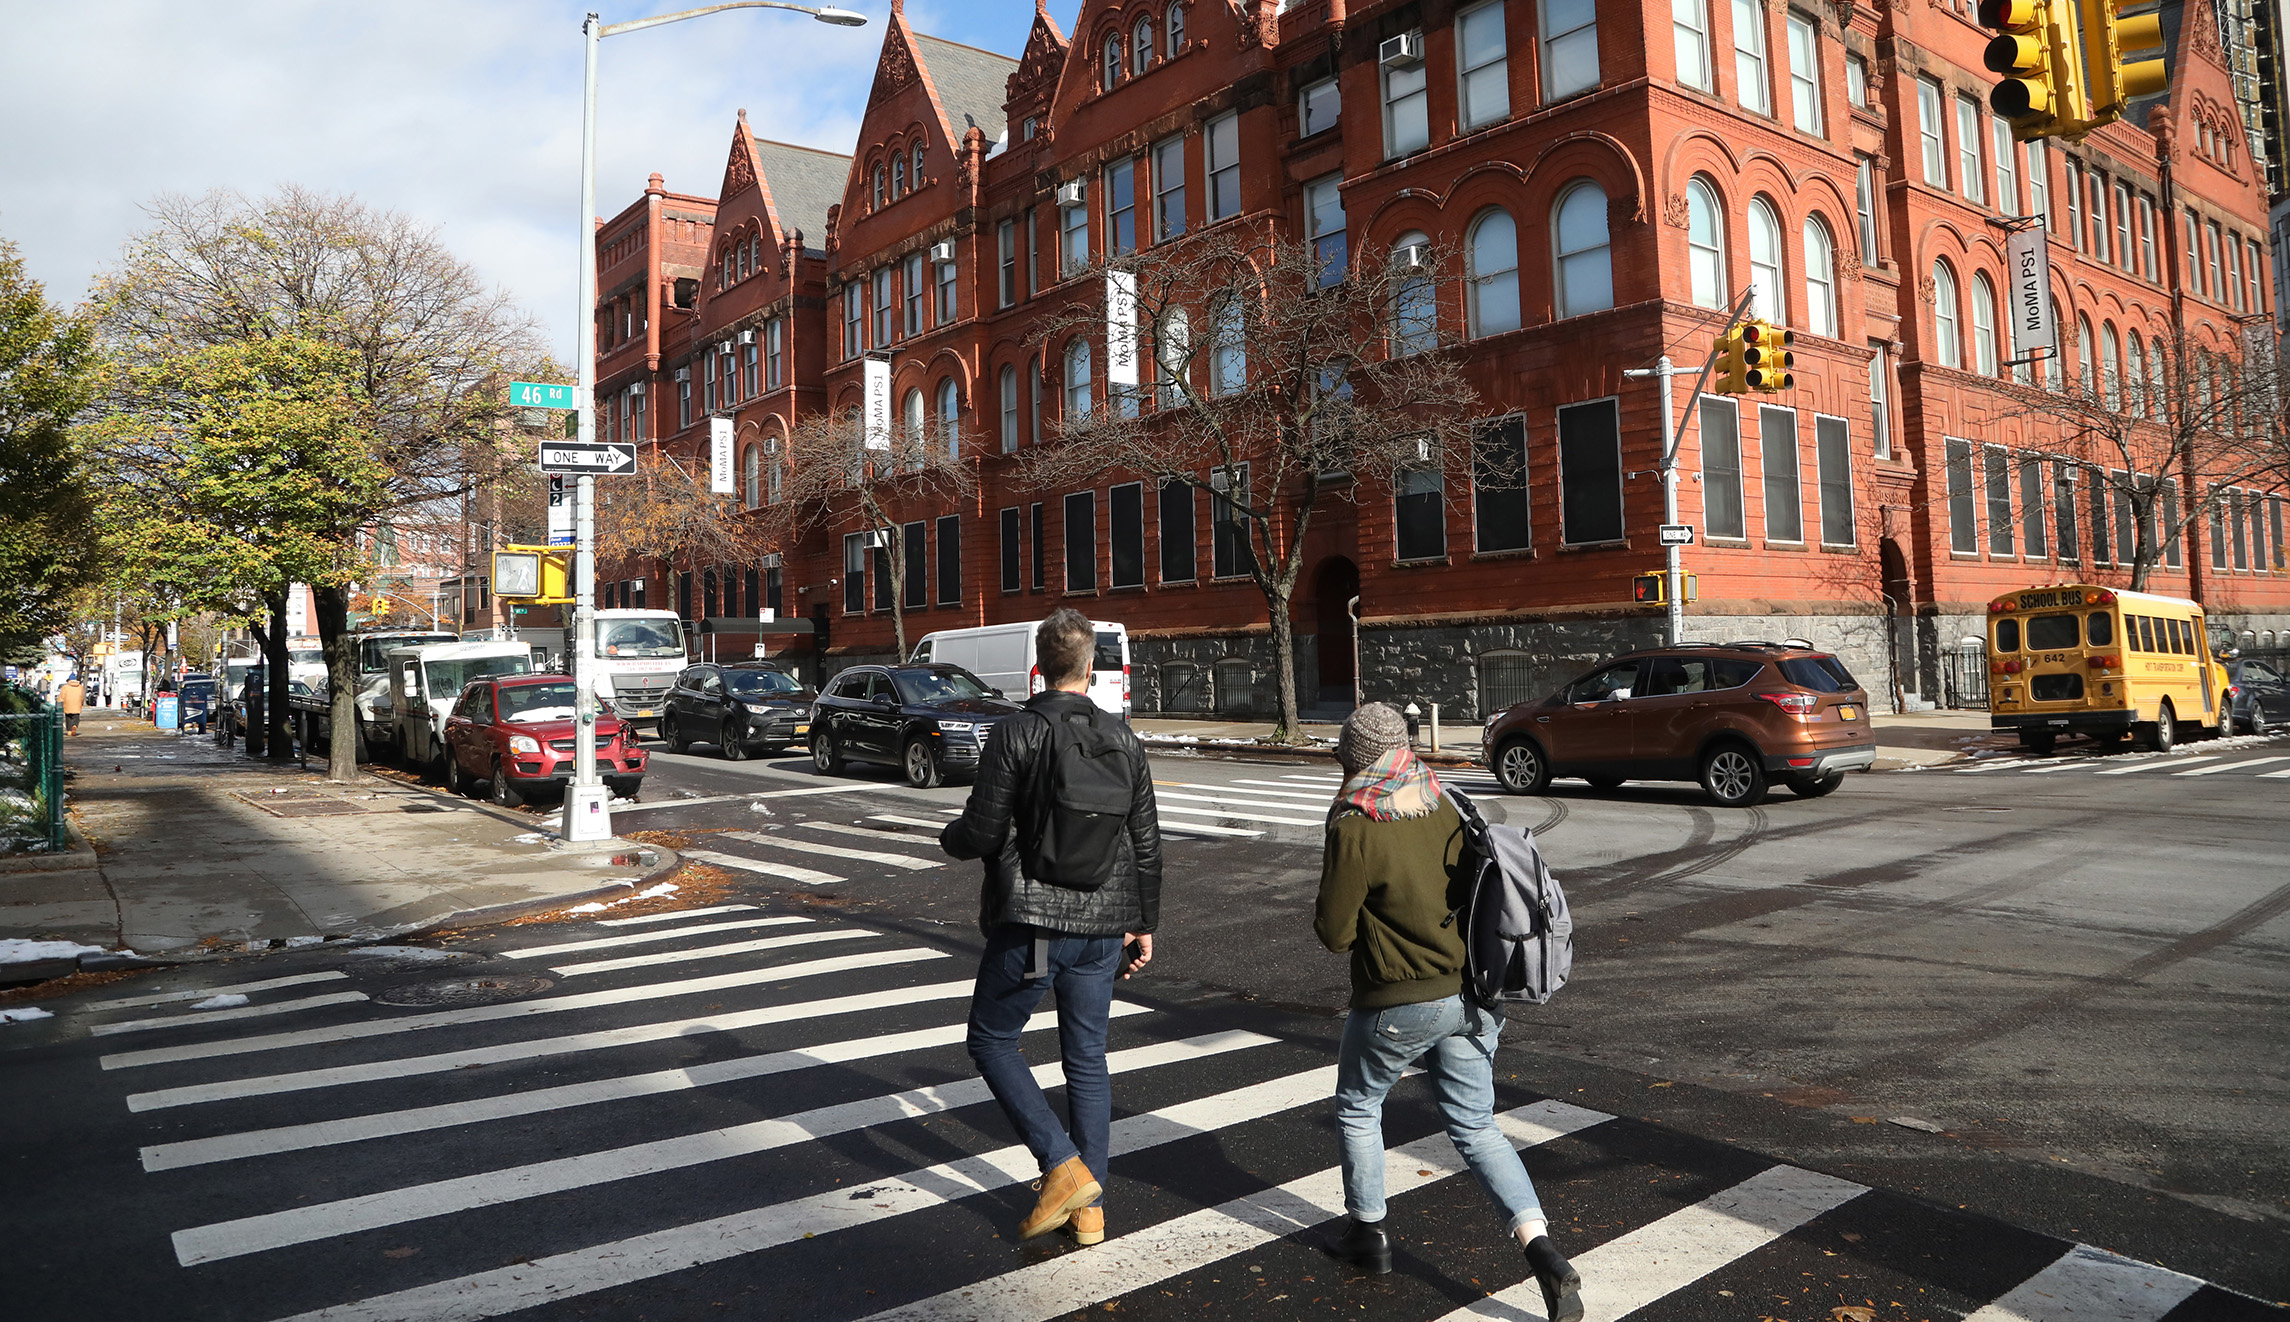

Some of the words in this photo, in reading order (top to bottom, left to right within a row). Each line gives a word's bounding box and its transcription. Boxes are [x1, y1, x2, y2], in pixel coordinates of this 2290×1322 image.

[2021, 247, 2036, 278] PS1
[2024, 280, 2041, 331] MoMA
[1118, 320, 1129, 367] MoMA
[521, 386, 542, 404] 46
[549, 388, 562, 399] Rd
[874, 374, 883, 397] PS1
[719, 430, 727, 449] PS1
[553, 451, 579, 464] ONE
[594, 453, 621, 465] WAY
[719, 450, 727, 482] MoMA
[552, 493, 560, 506] 2
[1666, 531, 1676, 539] ONE
[2020, 592, 2059, 609] SCHOOL
[2061, 590, 2082, 606] BUS
[2044, 653, 2065, 663] 642
[253, 675, 260, 683] P
